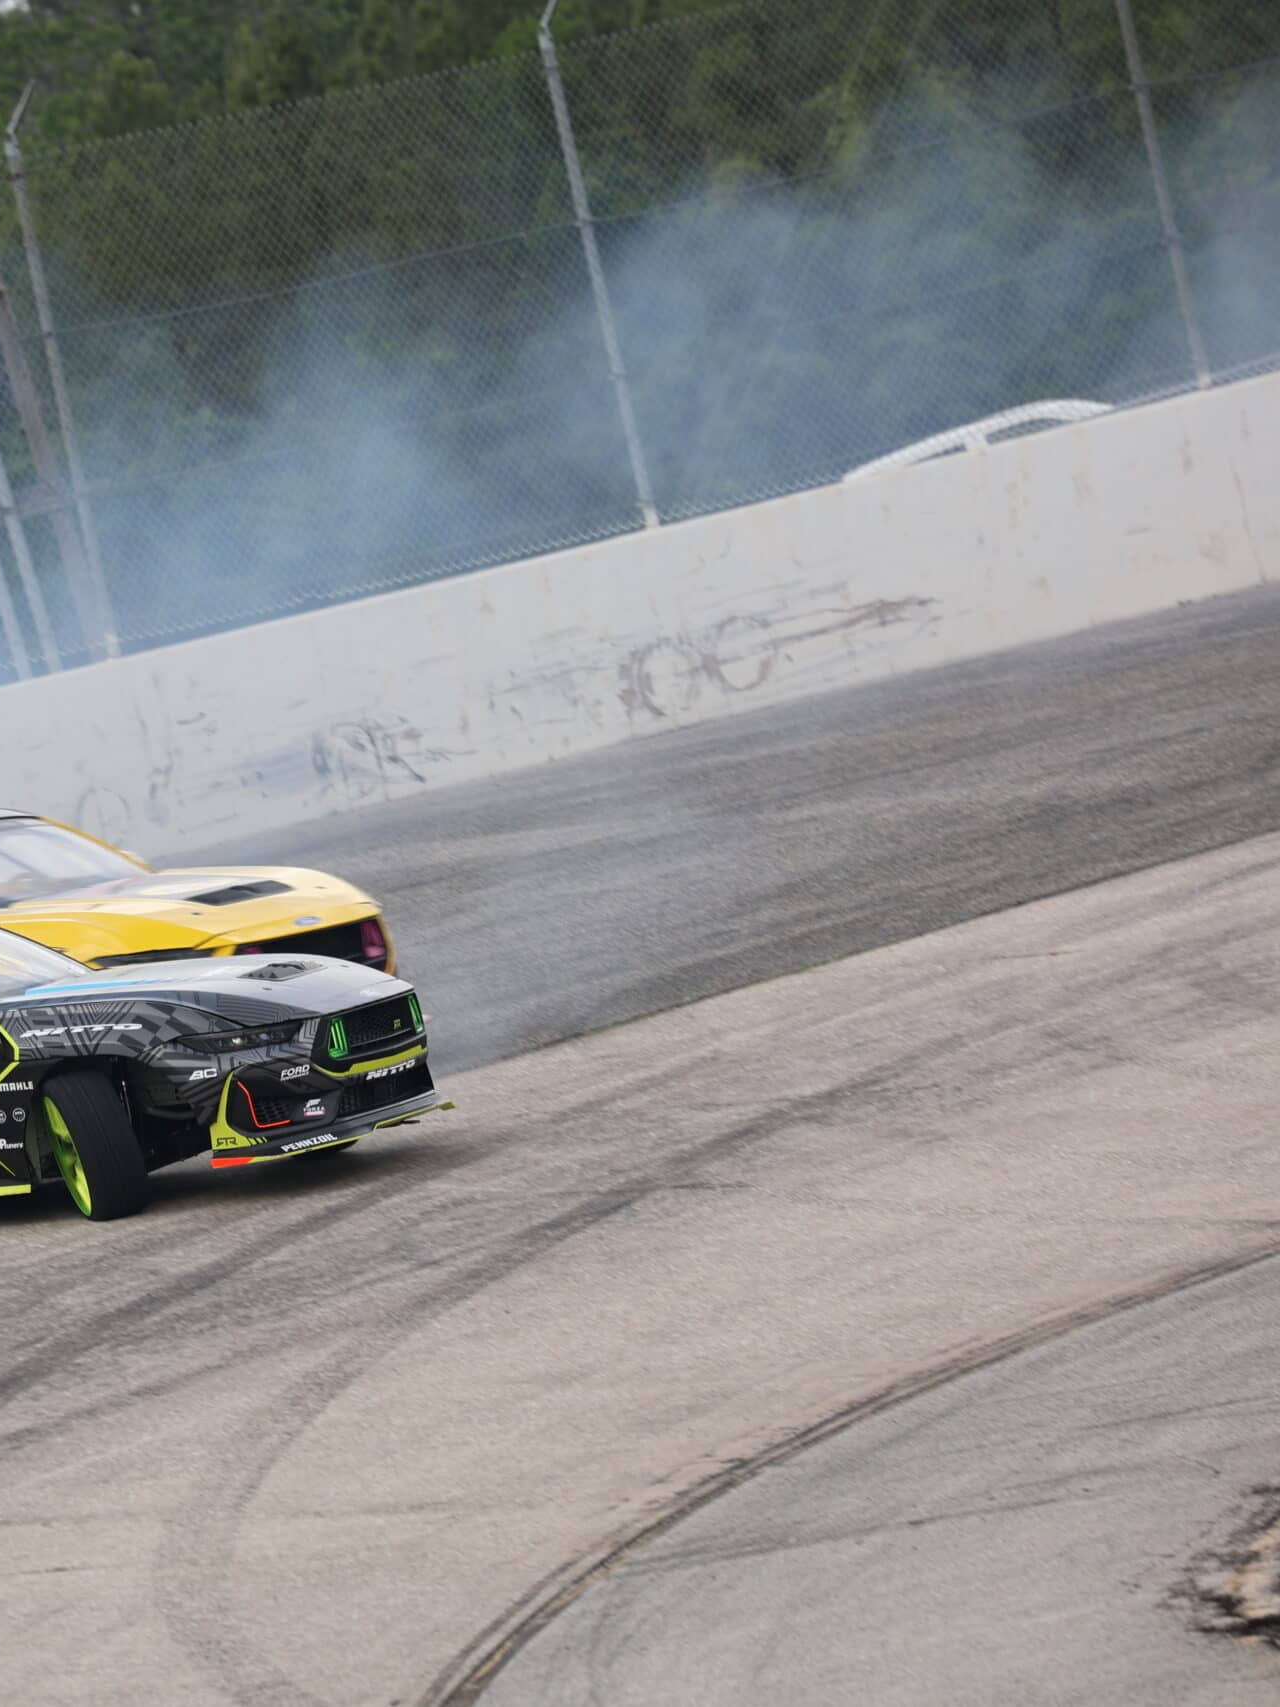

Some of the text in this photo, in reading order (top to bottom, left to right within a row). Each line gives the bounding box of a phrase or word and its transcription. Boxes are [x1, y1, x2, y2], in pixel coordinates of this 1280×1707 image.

[20, 1023, 143, 1039] NITTO
[281, 1064, 311, 1078] FORD
[366, 1059, 416, 1080] NITTO
[280, 1133, 338, 1152] PENNZOIL
